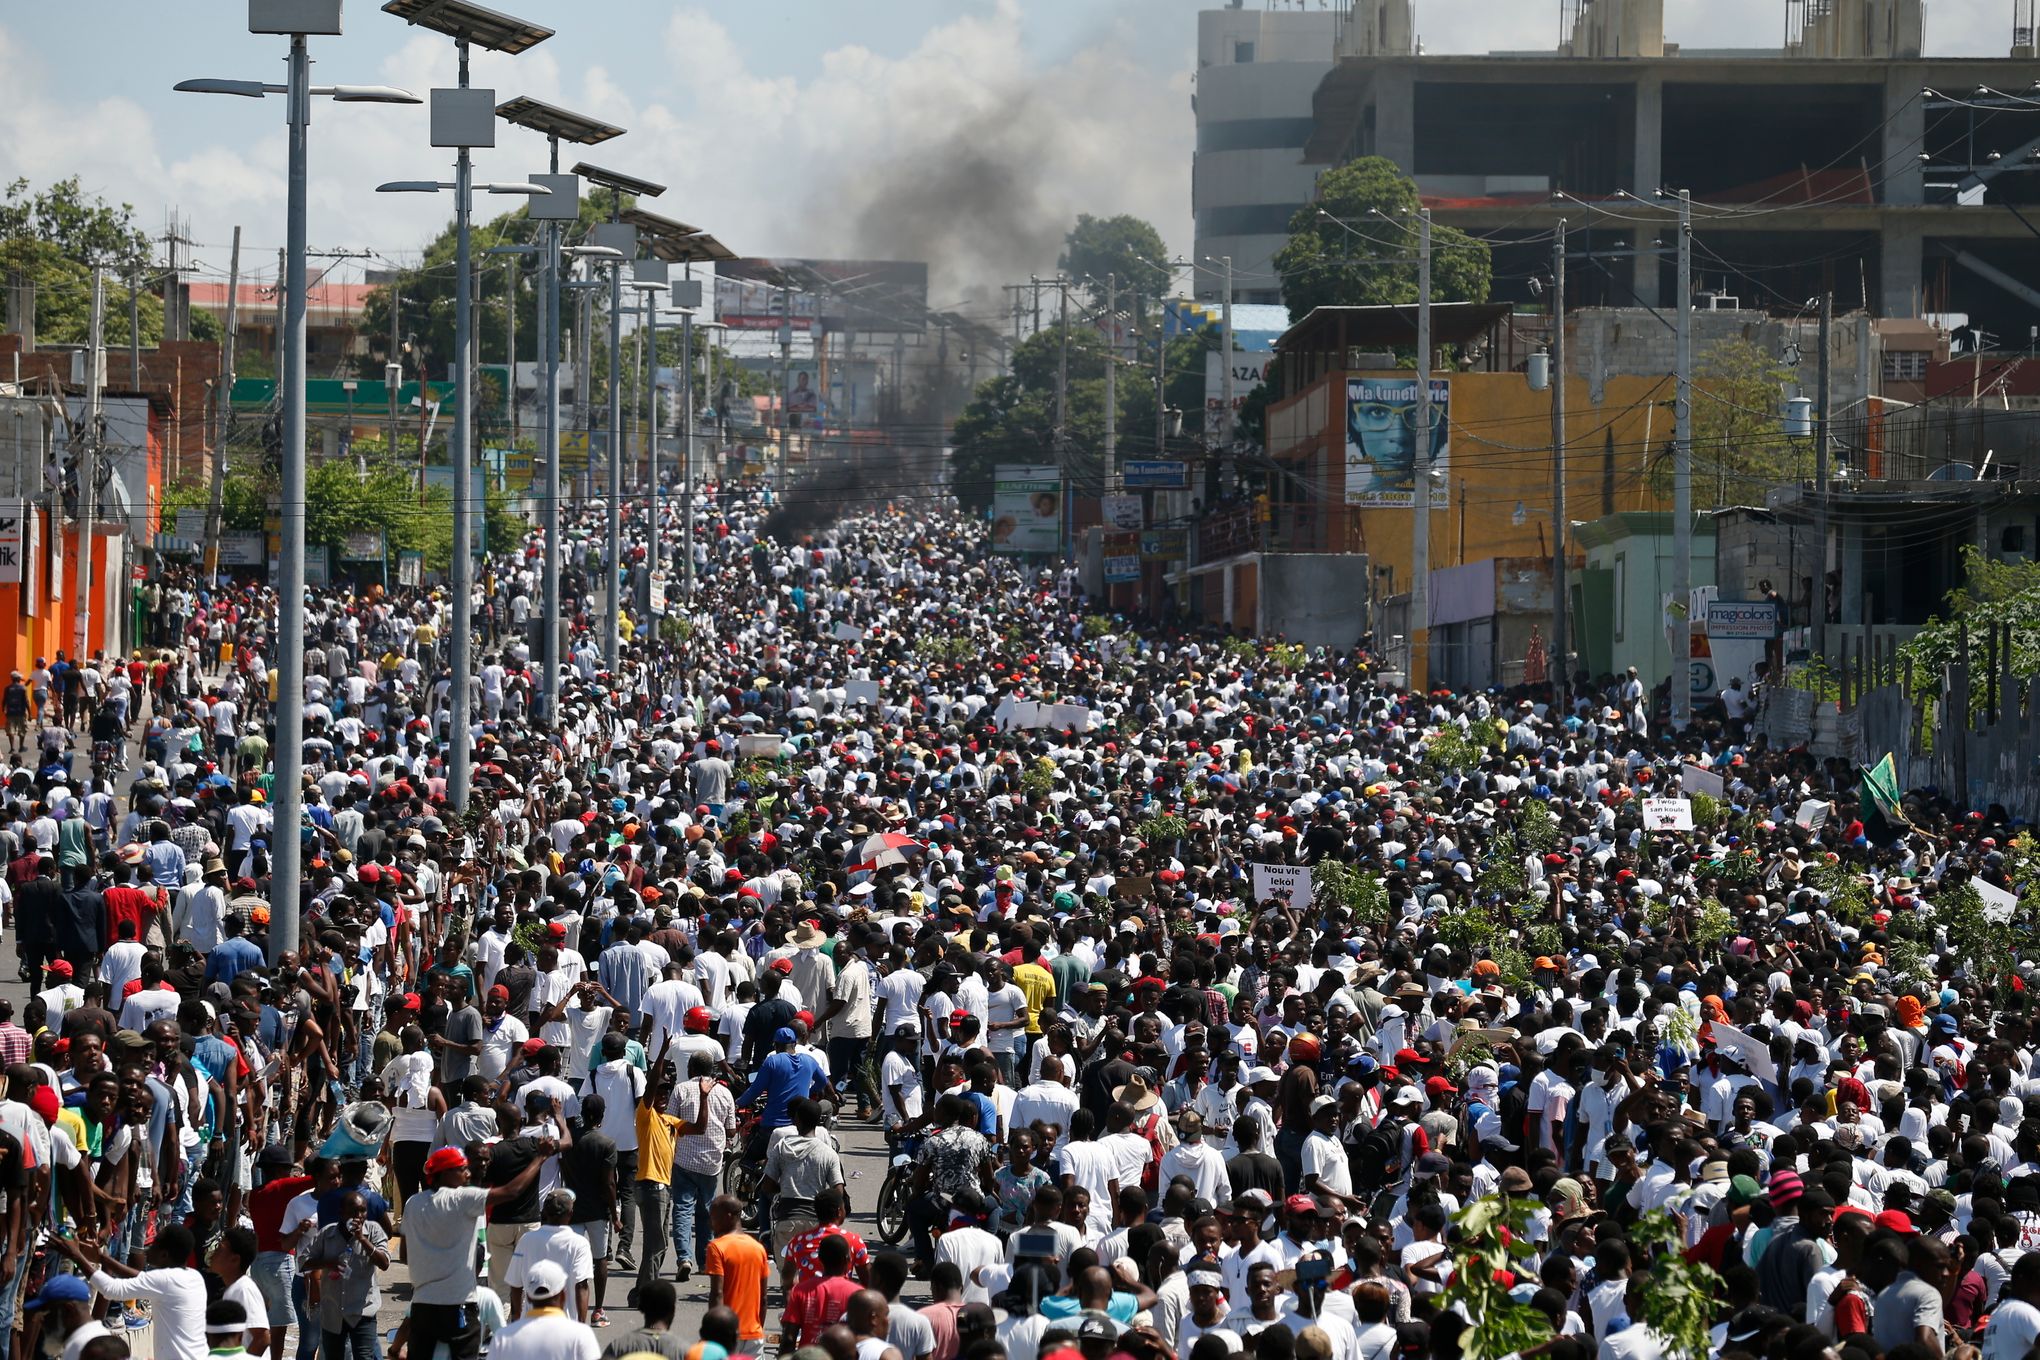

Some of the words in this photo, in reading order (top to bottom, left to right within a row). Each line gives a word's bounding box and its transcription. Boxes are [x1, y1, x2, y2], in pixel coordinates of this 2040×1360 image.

[1232, 367, 1260, 381] AZA
[1348, 384, 1373, 400] Ma
[1375, 385, 1447, 401] Lunettrie
[1711, 606, 1773, 624] magicolors
[1264, 865, 1284, 874] Nou
[1286, 867, 1301, 875] vle
